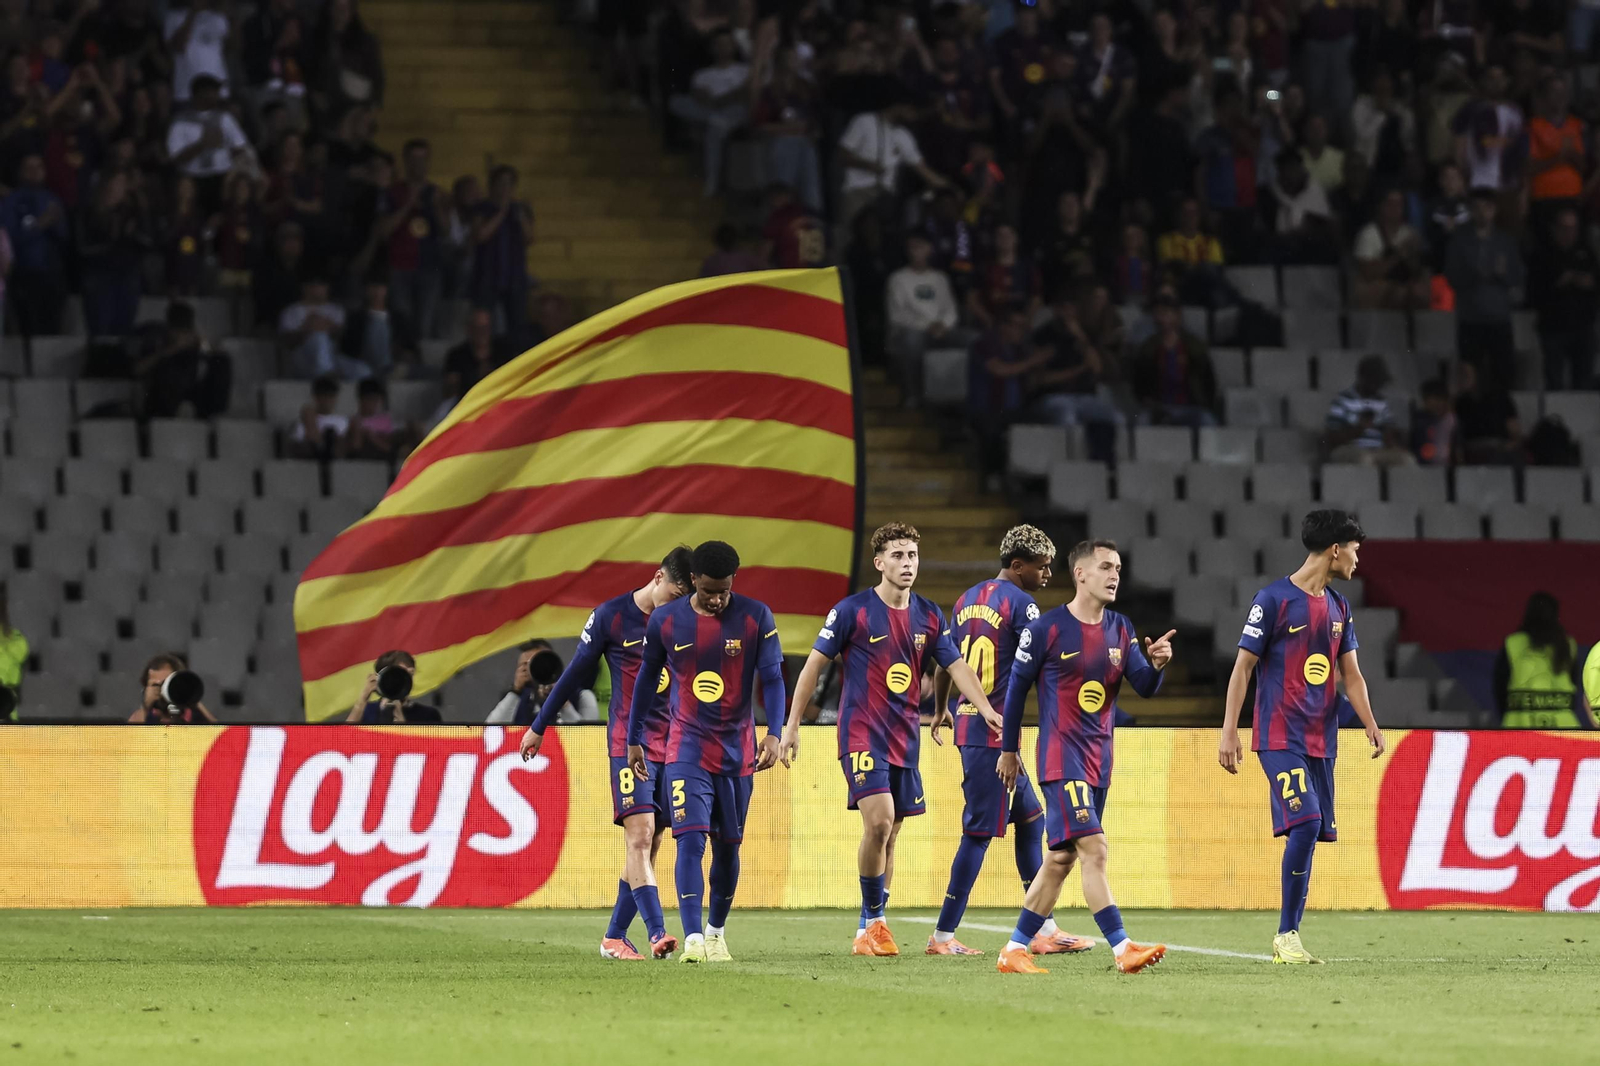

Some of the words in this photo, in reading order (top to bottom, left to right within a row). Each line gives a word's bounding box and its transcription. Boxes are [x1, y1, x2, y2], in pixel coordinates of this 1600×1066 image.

[959, 634, 995, 696] 10
[849, 751, 874, 772] 16
[618, 767, 635, 795] 8
[671, 779, 686, 807] 3
[1063, 780, 1090, 808] 17
[1276, 767, 1308, 800] 27
[215, 725, 550, 908] Lay's
